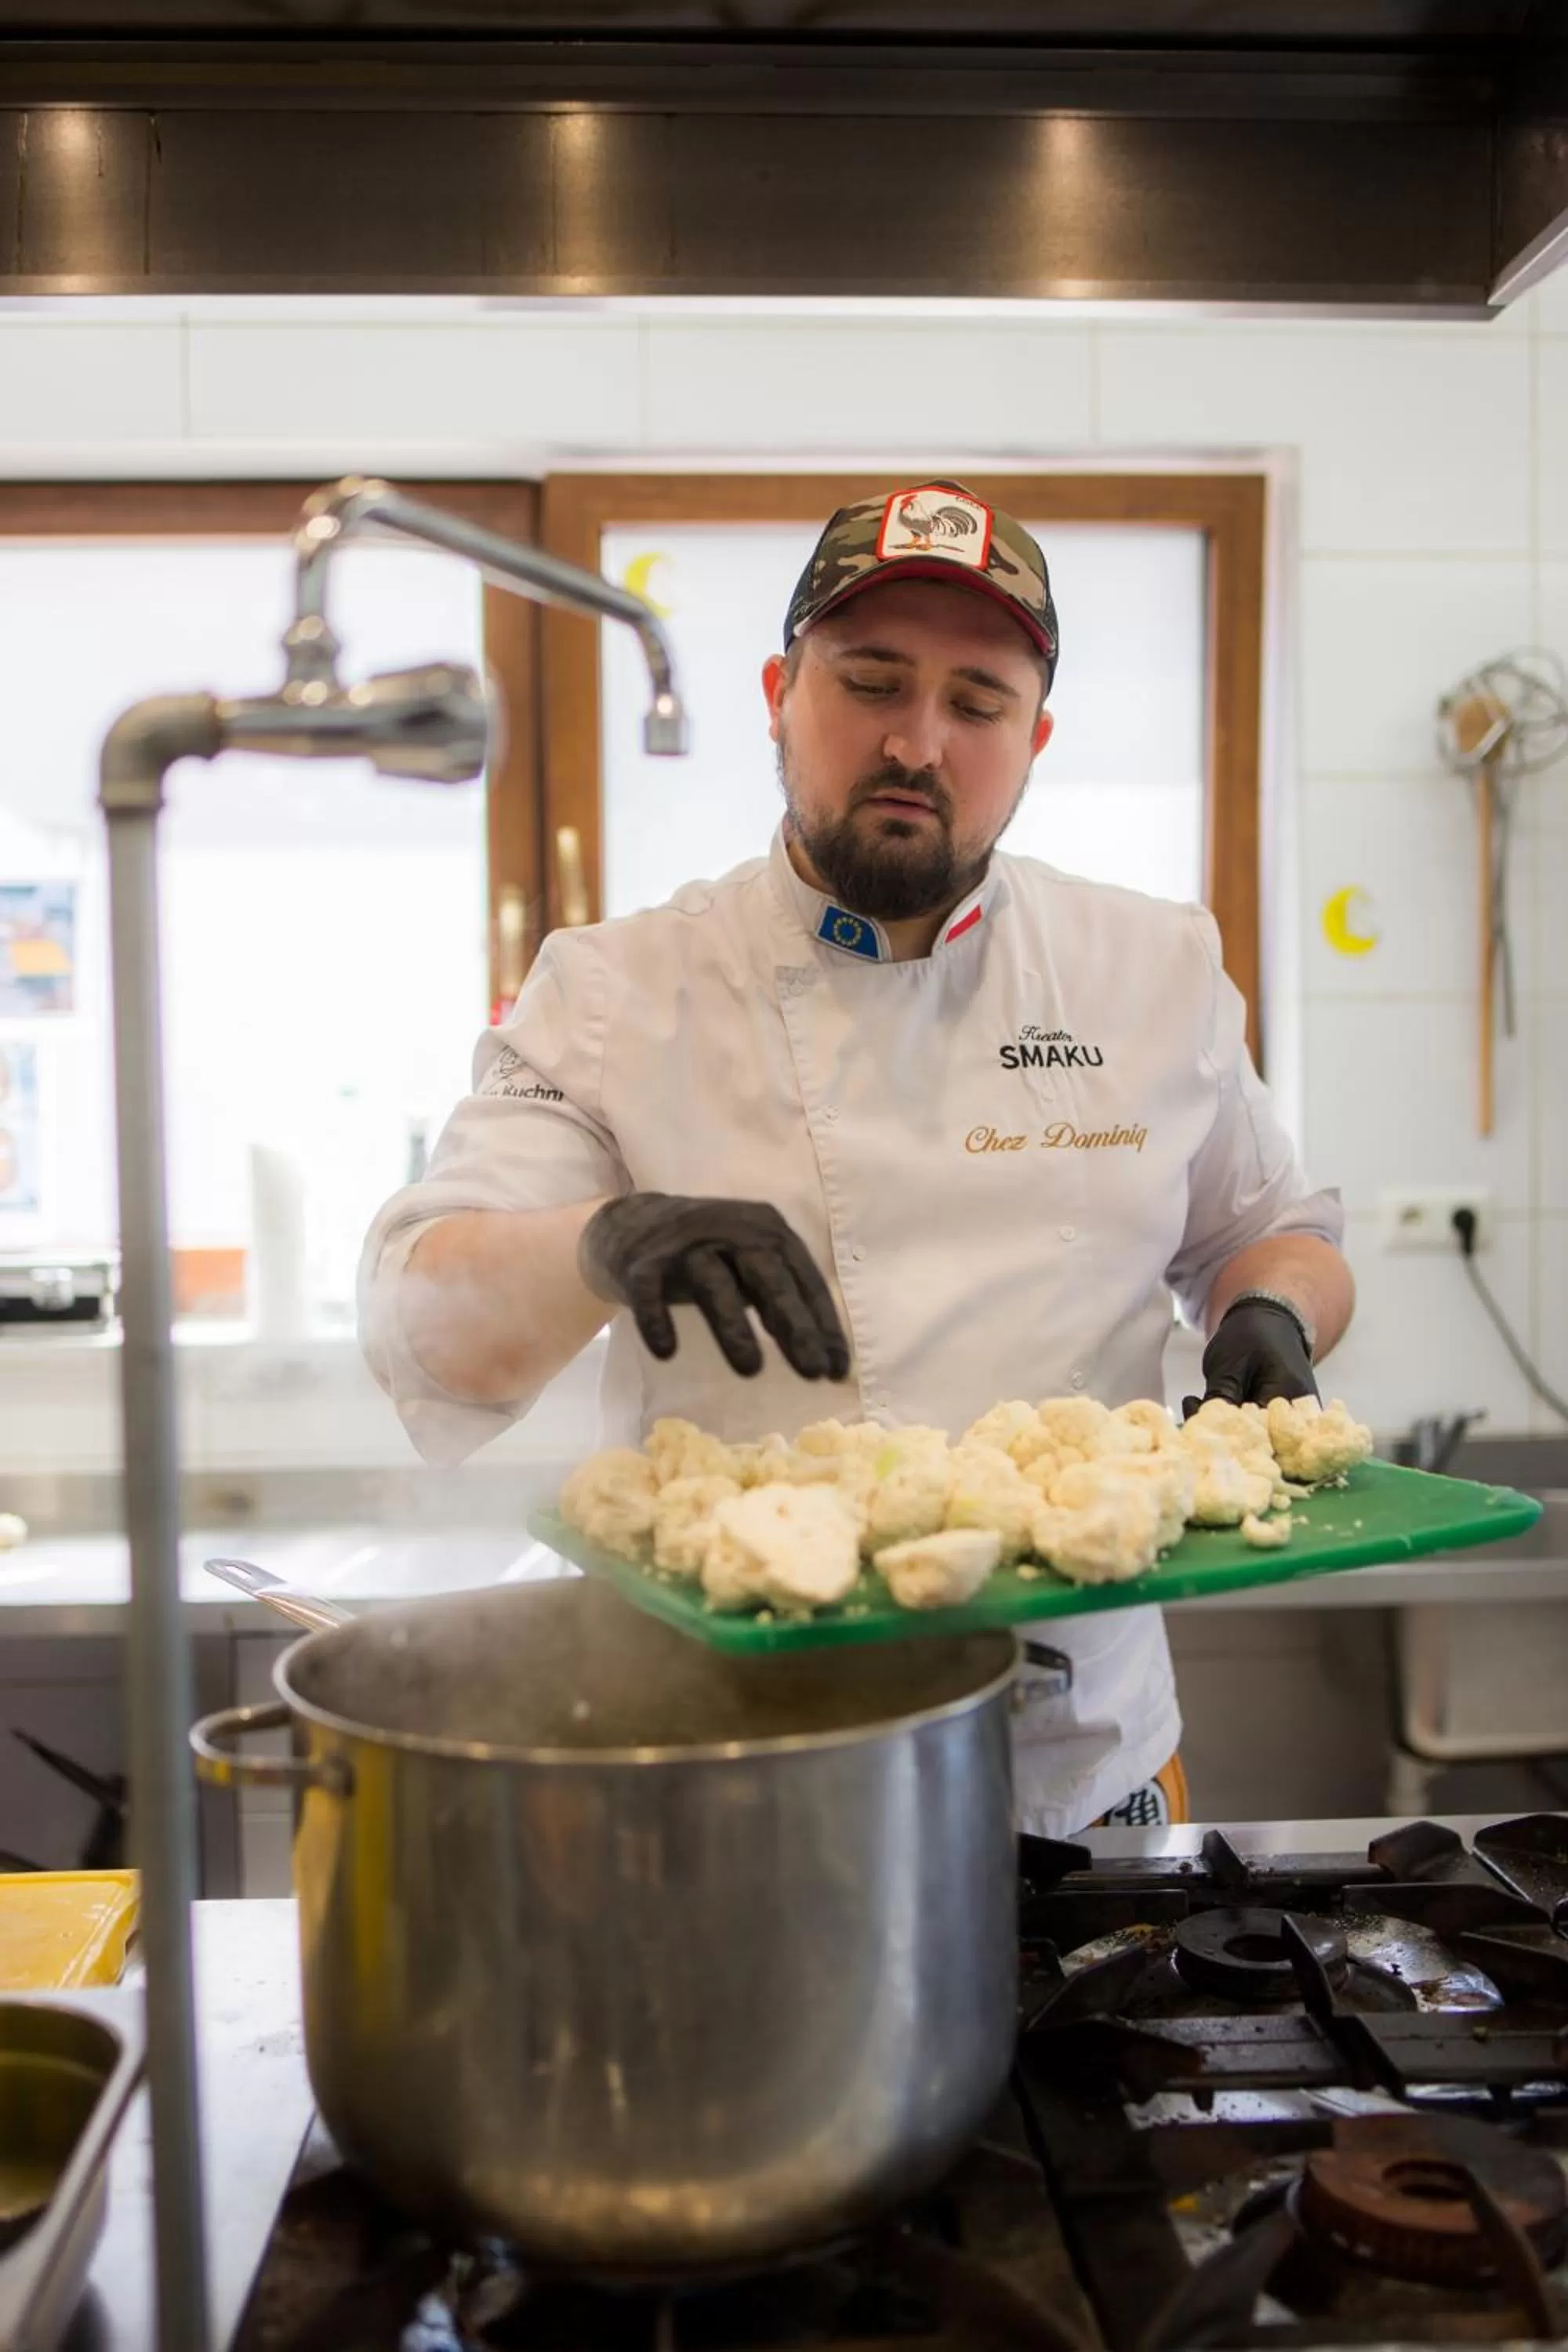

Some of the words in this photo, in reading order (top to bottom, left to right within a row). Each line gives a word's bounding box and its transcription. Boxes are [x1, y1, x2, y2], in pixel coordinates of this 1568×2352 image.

[1000, 1045, 1104, 1069] SMAKU
[965, 1126, 1027, 1154] Chez
[1041, 1123, 1148, 1153] Dominiq
